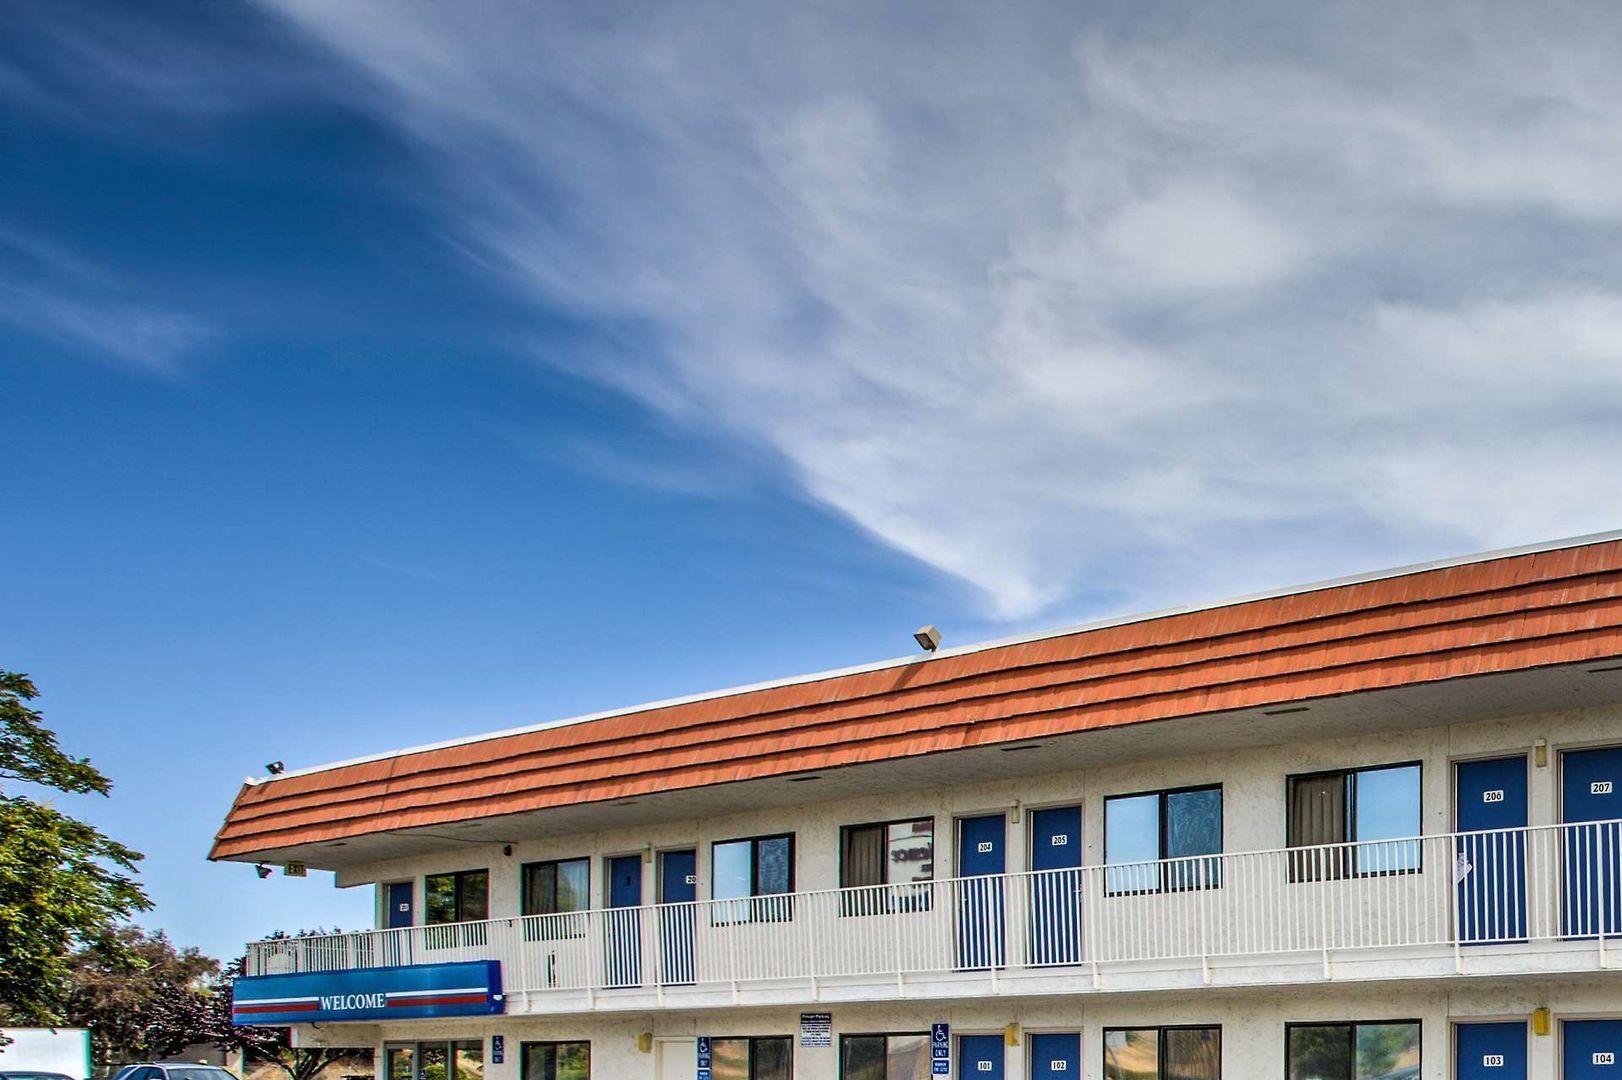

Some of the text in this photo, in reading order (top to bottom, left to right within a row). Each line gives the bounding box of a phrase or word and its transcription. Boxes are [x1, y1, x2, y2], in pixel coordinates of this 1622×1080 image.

[1593, 783, 1610, 792] 207
[1486, 791, 1502, 801] 206
[1054, 836, 1066, 844] 205
[980, 843, 991, 851] 204
[320, 993, 385, 1011] WELCOME
[1486, 1056, 1501, 1065] 103
[1595, 1054, 1612, 1063] 104
[979, 1062, 990, 1070] 101
[1053, 1061, 1065, 1070] 102
